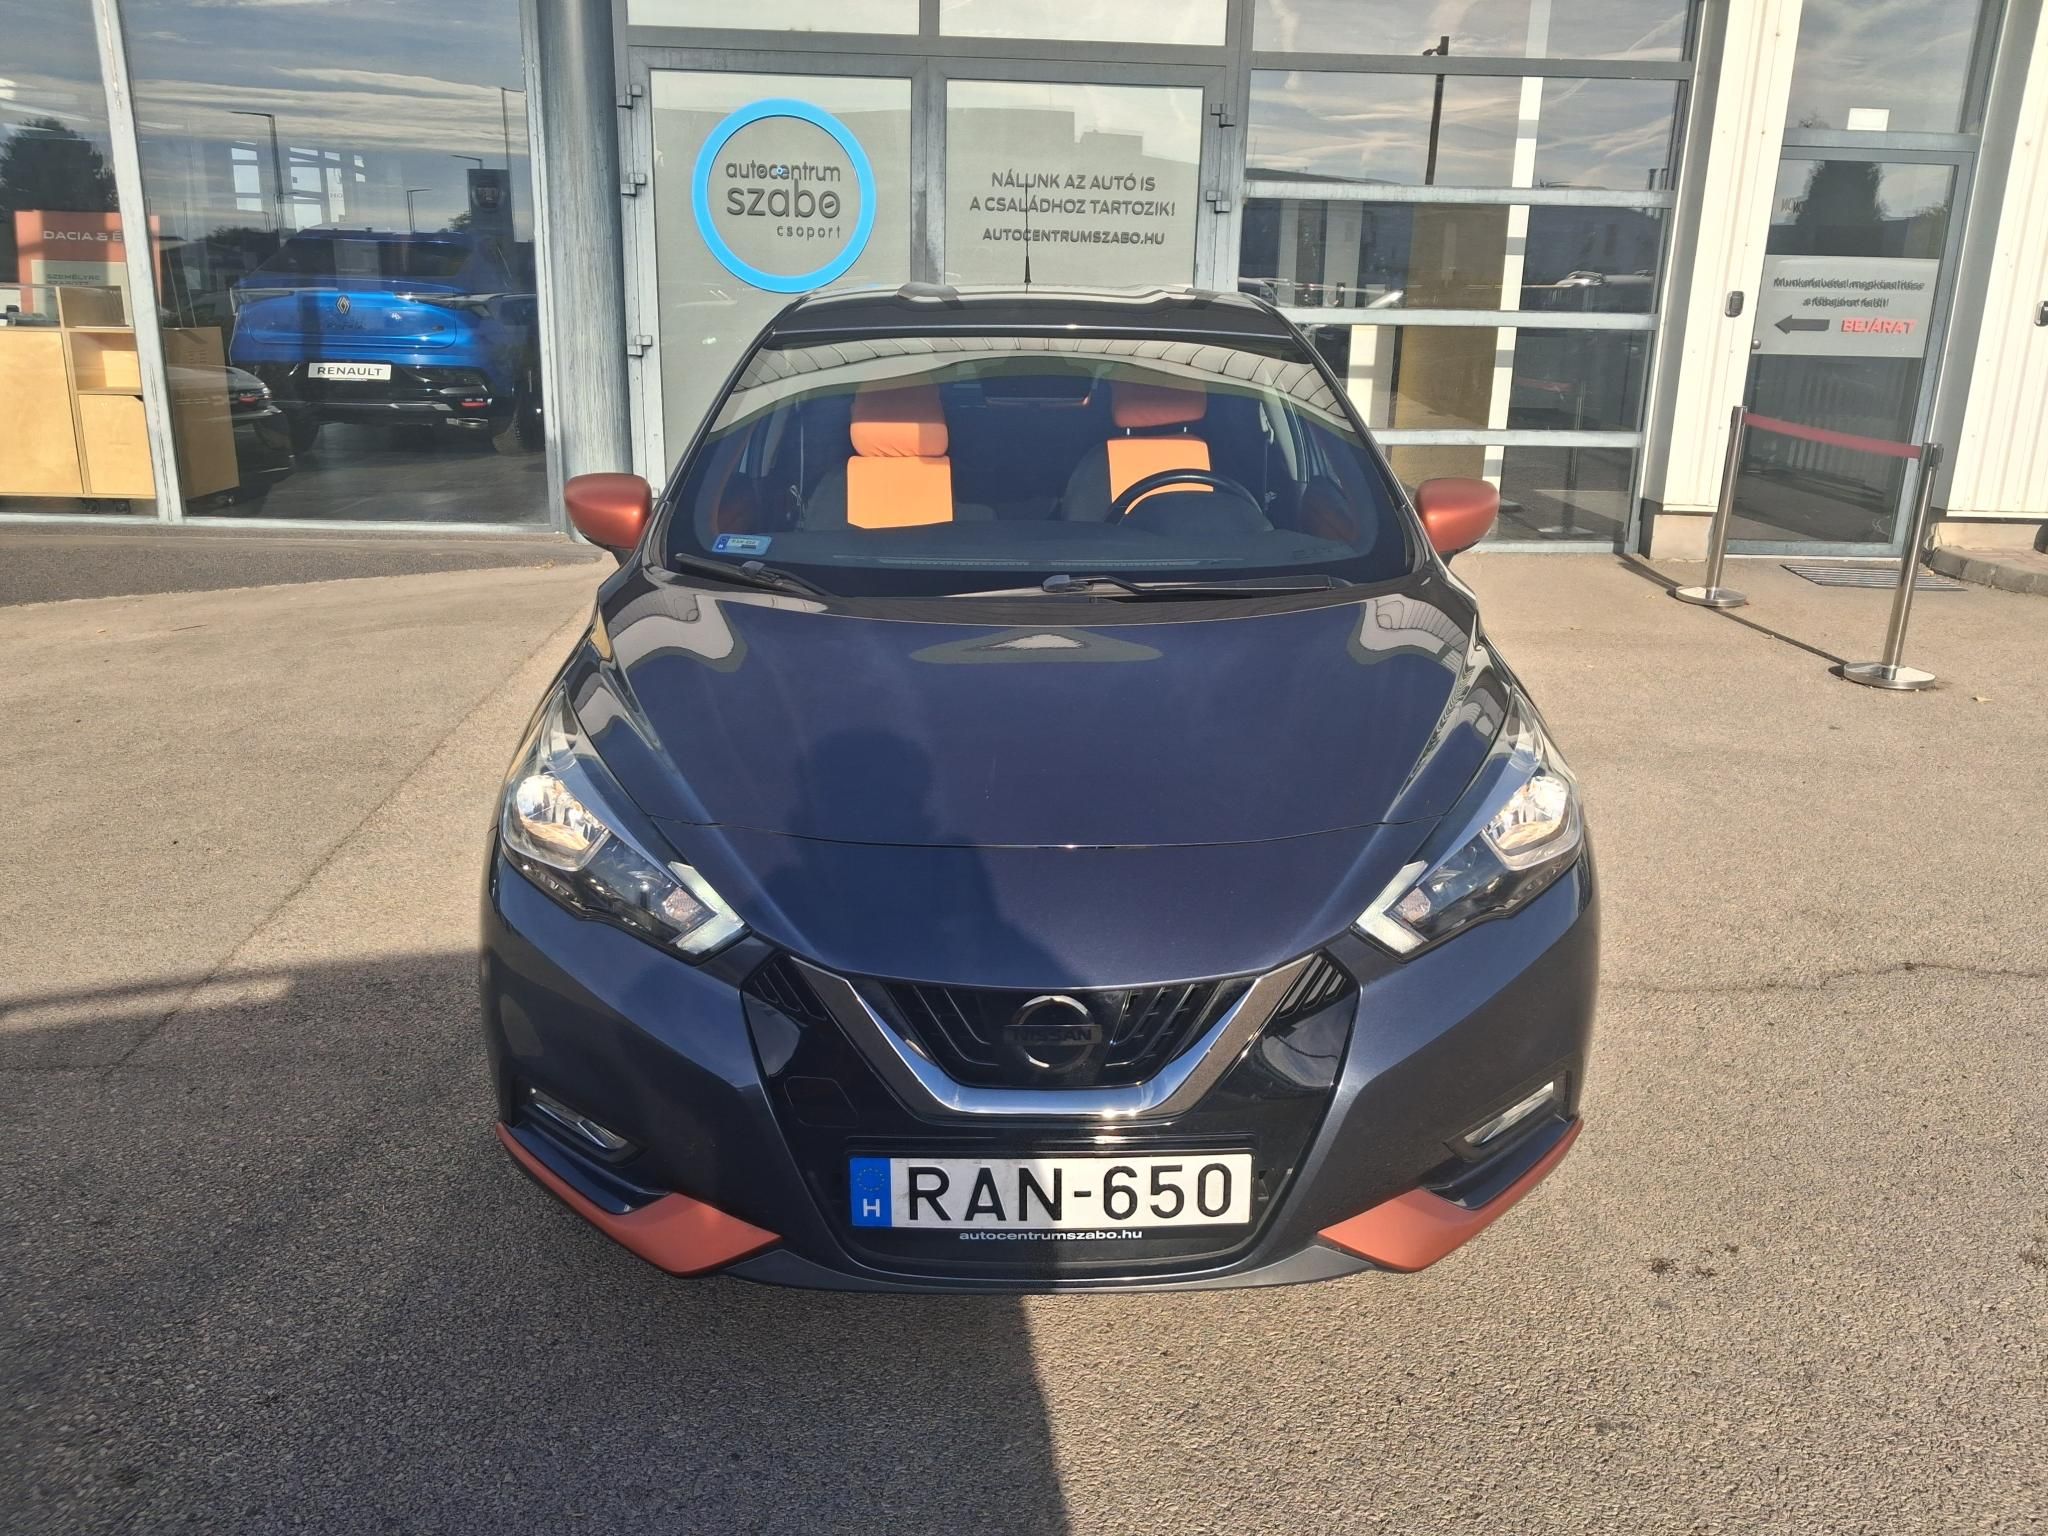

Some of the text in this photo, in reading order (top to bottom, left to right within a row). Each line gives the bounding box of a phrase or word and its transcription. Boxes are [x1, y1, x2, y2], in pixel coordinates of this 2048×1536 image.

[726, 160, 840, 181] autocentrum
[992, 169, 1155, 191] NÁLUNK AZ AUTÓ IS
[969, 195, 1176, 216] A CSALÁDHOZ TARTOZIK!
[43, 230, 123, 242] DACIA & É
[777, 225, 840, 240] csoport
[983, 228, 1165, 245] AUTOCENTRUMSZABO.HU
[1841, 316, 1918, 335] BEJÁRAT
[317, 366, 383, 377] RENAULT
[1014, 1029, 1092, 1042] NISSAN
[863, 1163, 1232, 1222] H RAN-650
[959, 1229, 1143, 1241] autocentrumszabo.hu
